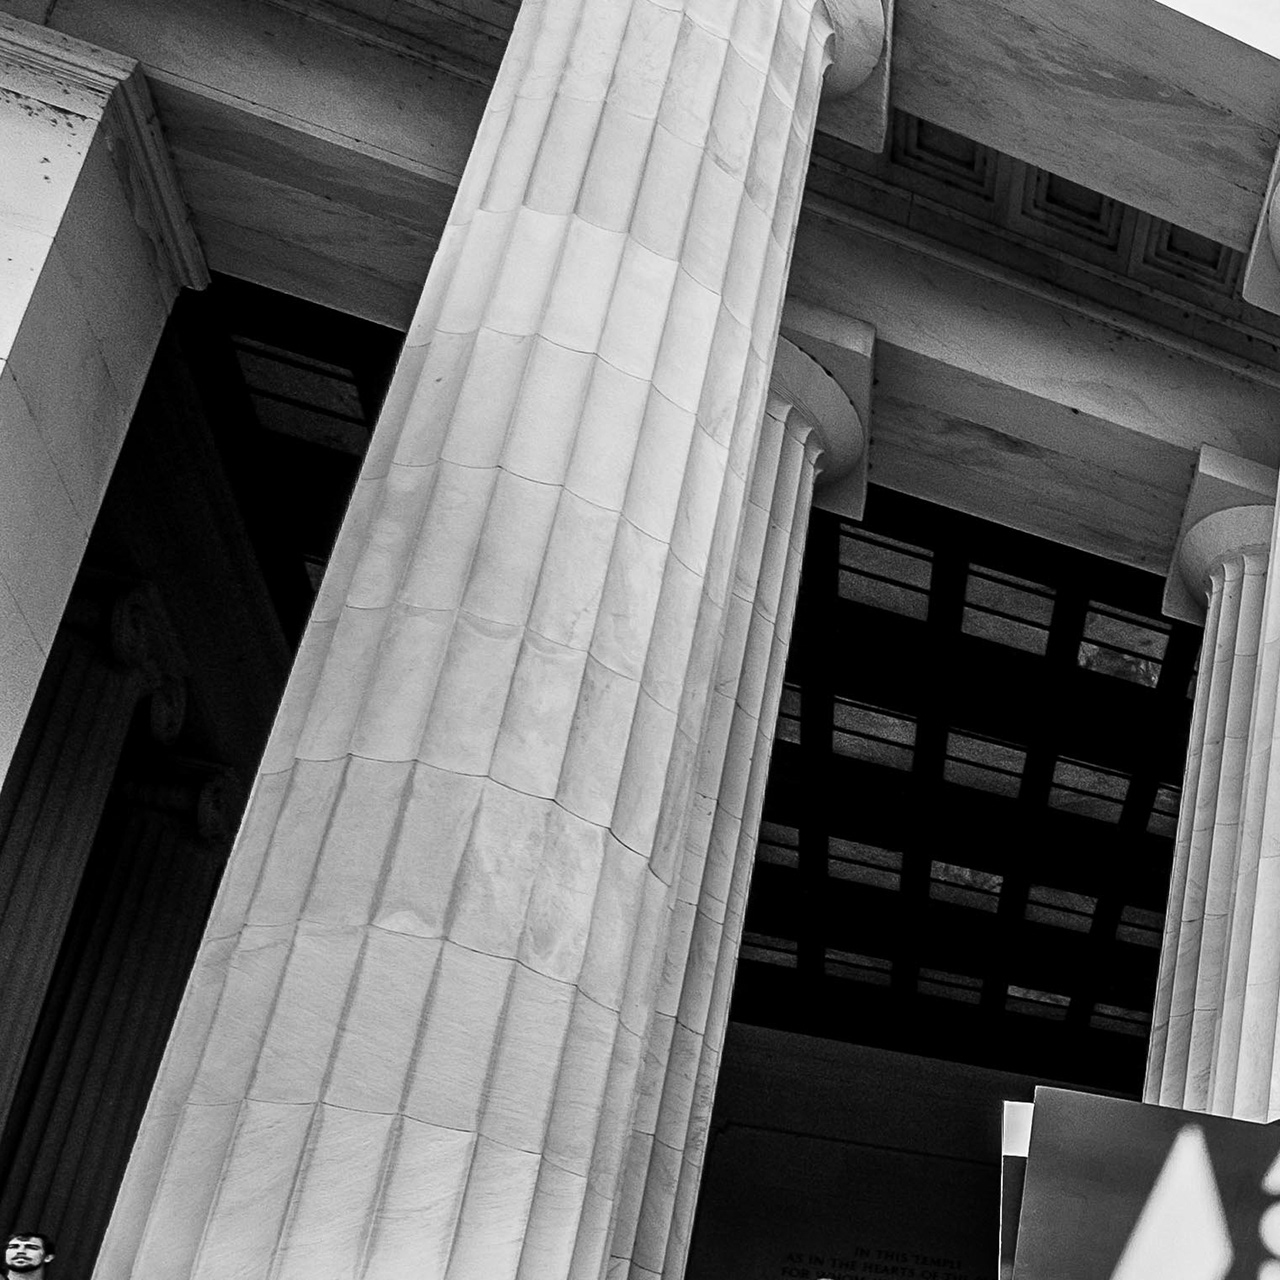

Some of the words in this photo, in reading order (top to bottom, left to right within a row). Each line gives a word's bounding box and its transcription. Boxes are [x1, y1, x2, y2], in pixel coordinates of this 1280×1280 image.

[854, 1246, 870, 1258] IN
[876, 1249, 908, 1263] THIS
[781, 1266, 810, 1279] FOR
[808, 1254, 825, 1266] IN
[830, 1258, 857, 1271] THE
[862, 1262, 915, 1278] HEARTS
[921, 1269, 939, 1280] OF
